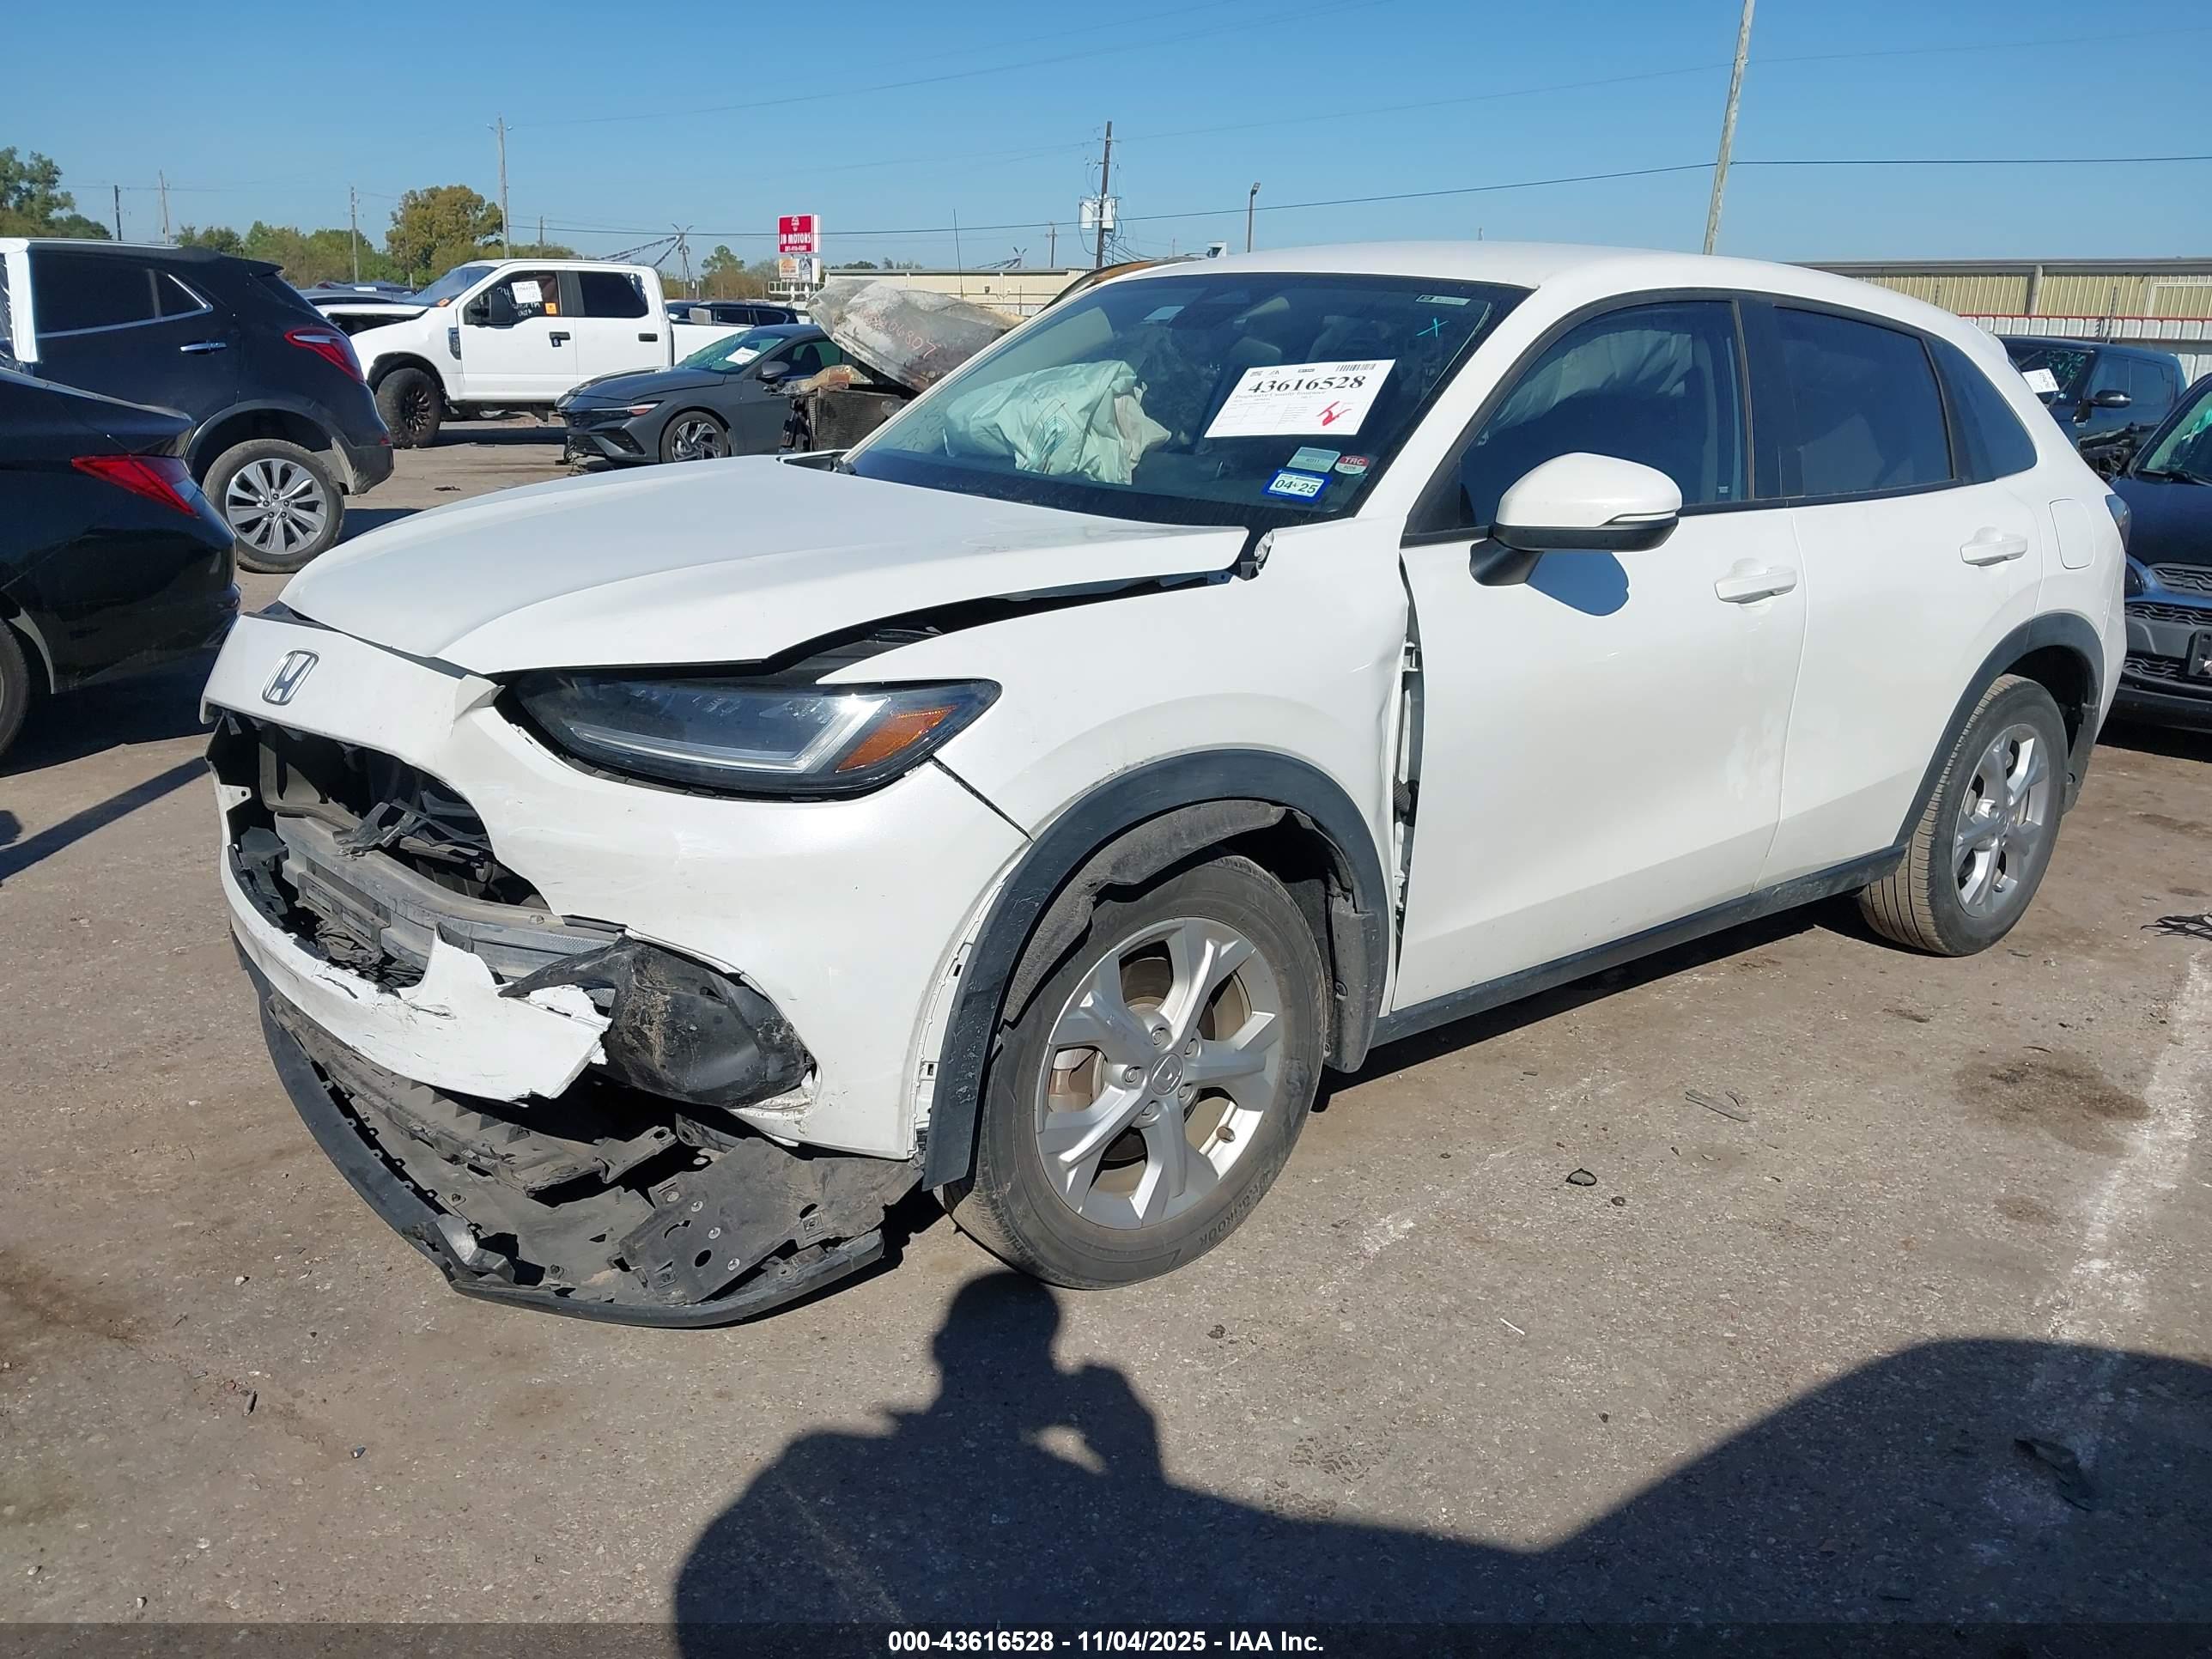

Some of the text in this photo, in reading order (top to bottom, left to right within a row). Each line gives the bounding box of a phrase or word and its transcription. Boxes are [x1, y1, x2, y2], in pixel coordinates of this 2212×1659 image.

[787, 232, 811, 245] MOTORS
[1249, 375, 1366, 393] 43616528
[1344, 456, 1365, 465] TRC
[1274, 479, 1293, 489] 04
[1297, 483, 1318, 494] 25
